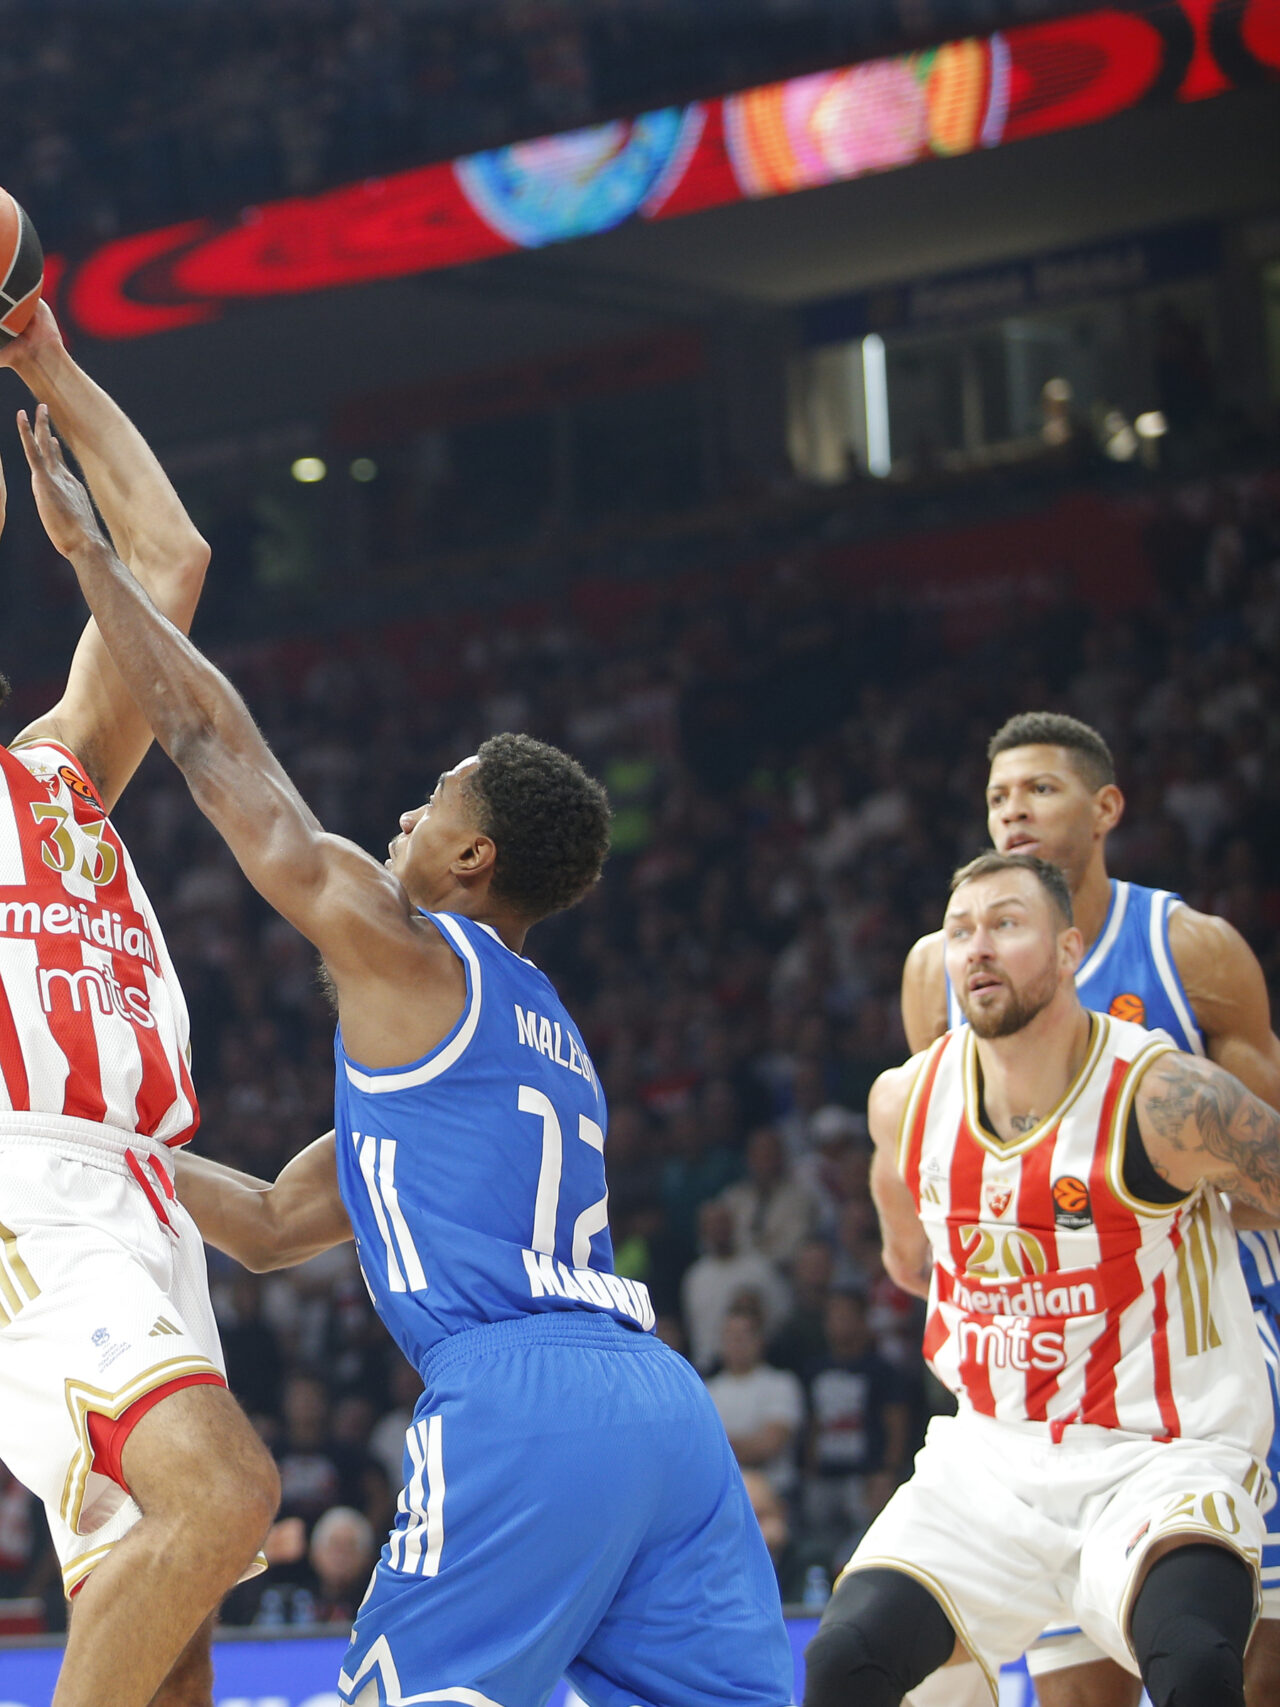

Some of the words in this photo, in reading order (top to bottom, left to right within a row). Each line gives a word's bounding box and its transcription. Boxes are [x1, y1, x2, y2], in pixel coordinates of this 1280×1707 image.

[29, 802, 118, 886] 33
[37, 964, 156, 1029] mts
[959, 1225, 1047, 1279] 20
[521, 1248, 656, 1332] MADRID
[958, 1317, 1065, 1370] mts
